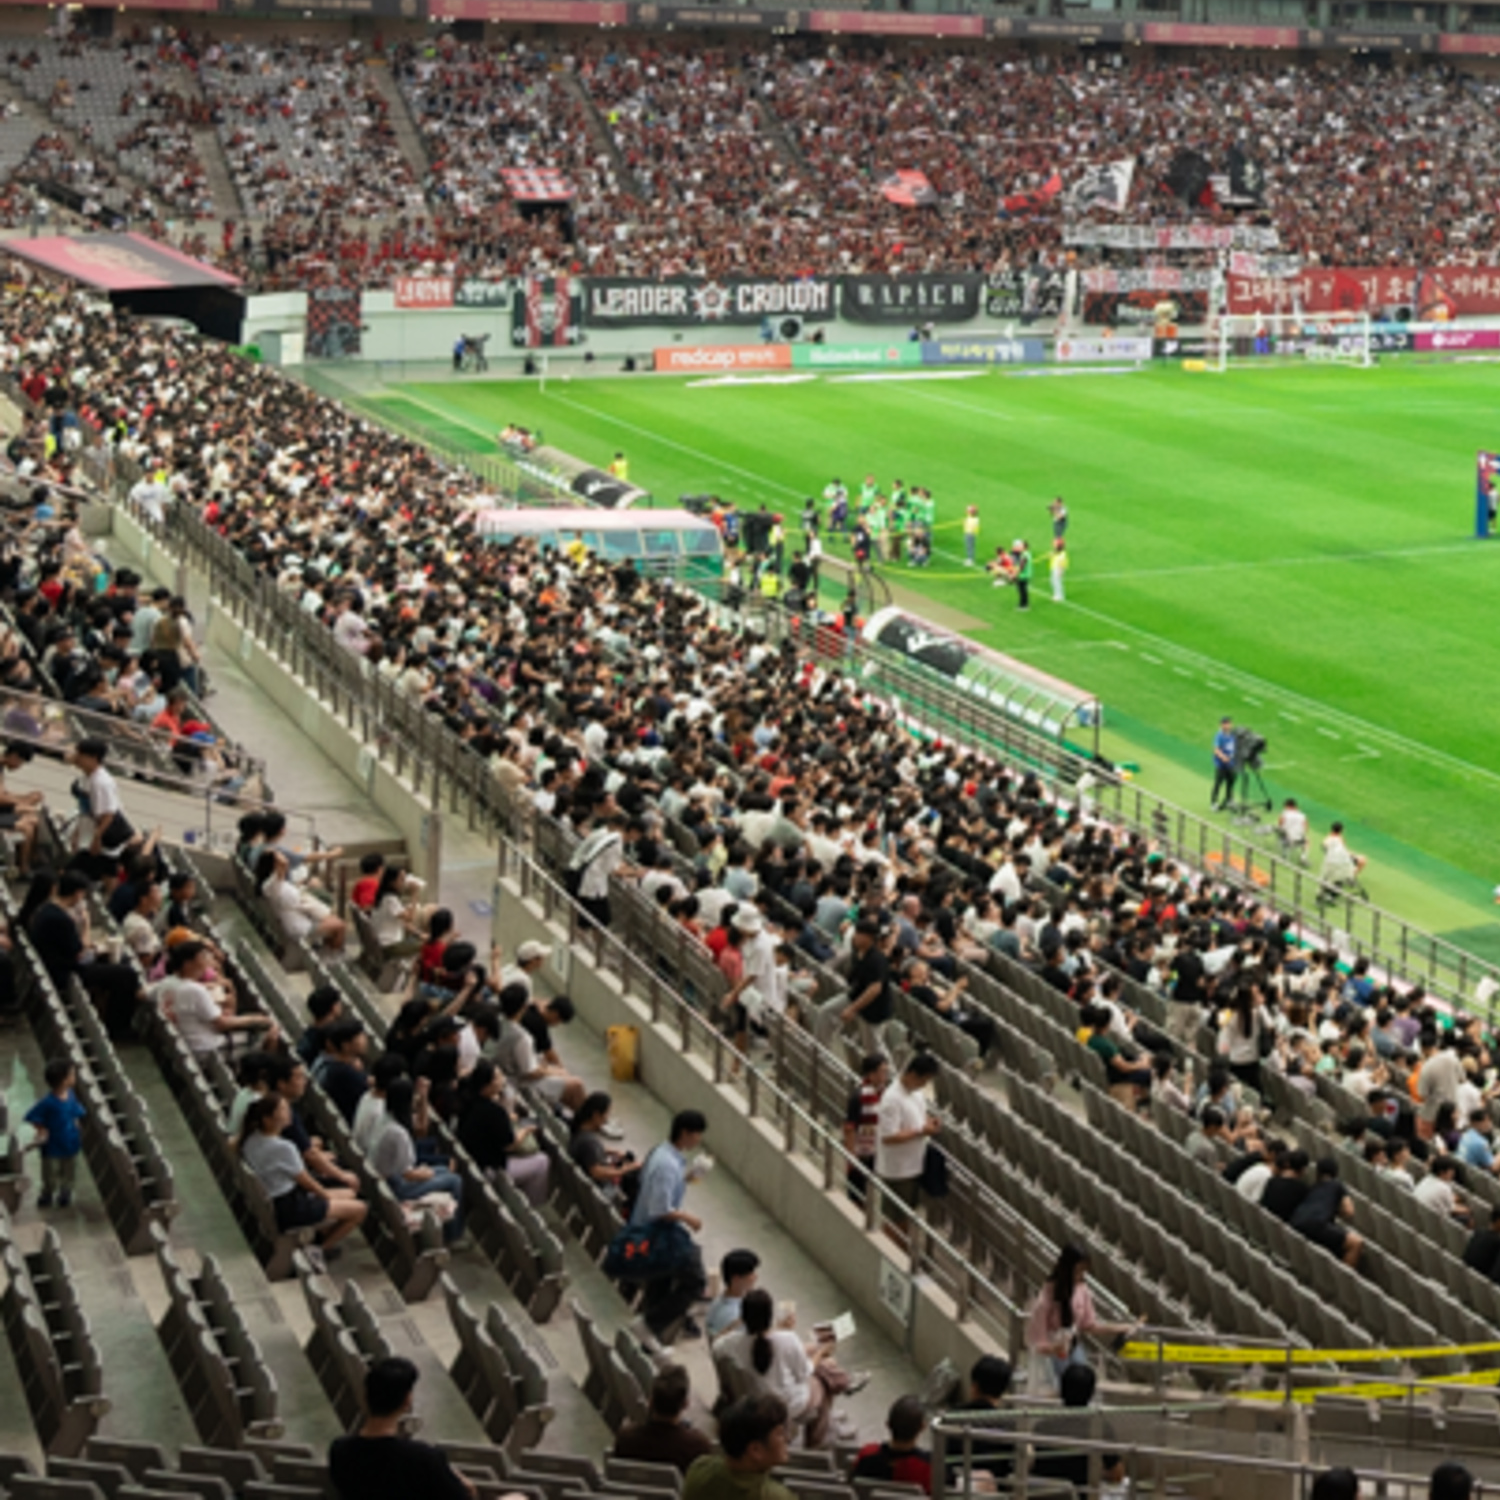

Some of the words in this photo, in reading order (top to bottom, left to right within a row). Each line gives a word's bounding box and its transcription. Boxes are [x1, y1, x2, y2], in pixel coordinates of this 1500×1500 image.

[592, 286, 688, 315] LEADER
[737, 282, 830, 313] CROWN
[671, 348, 736, 369] redcap
